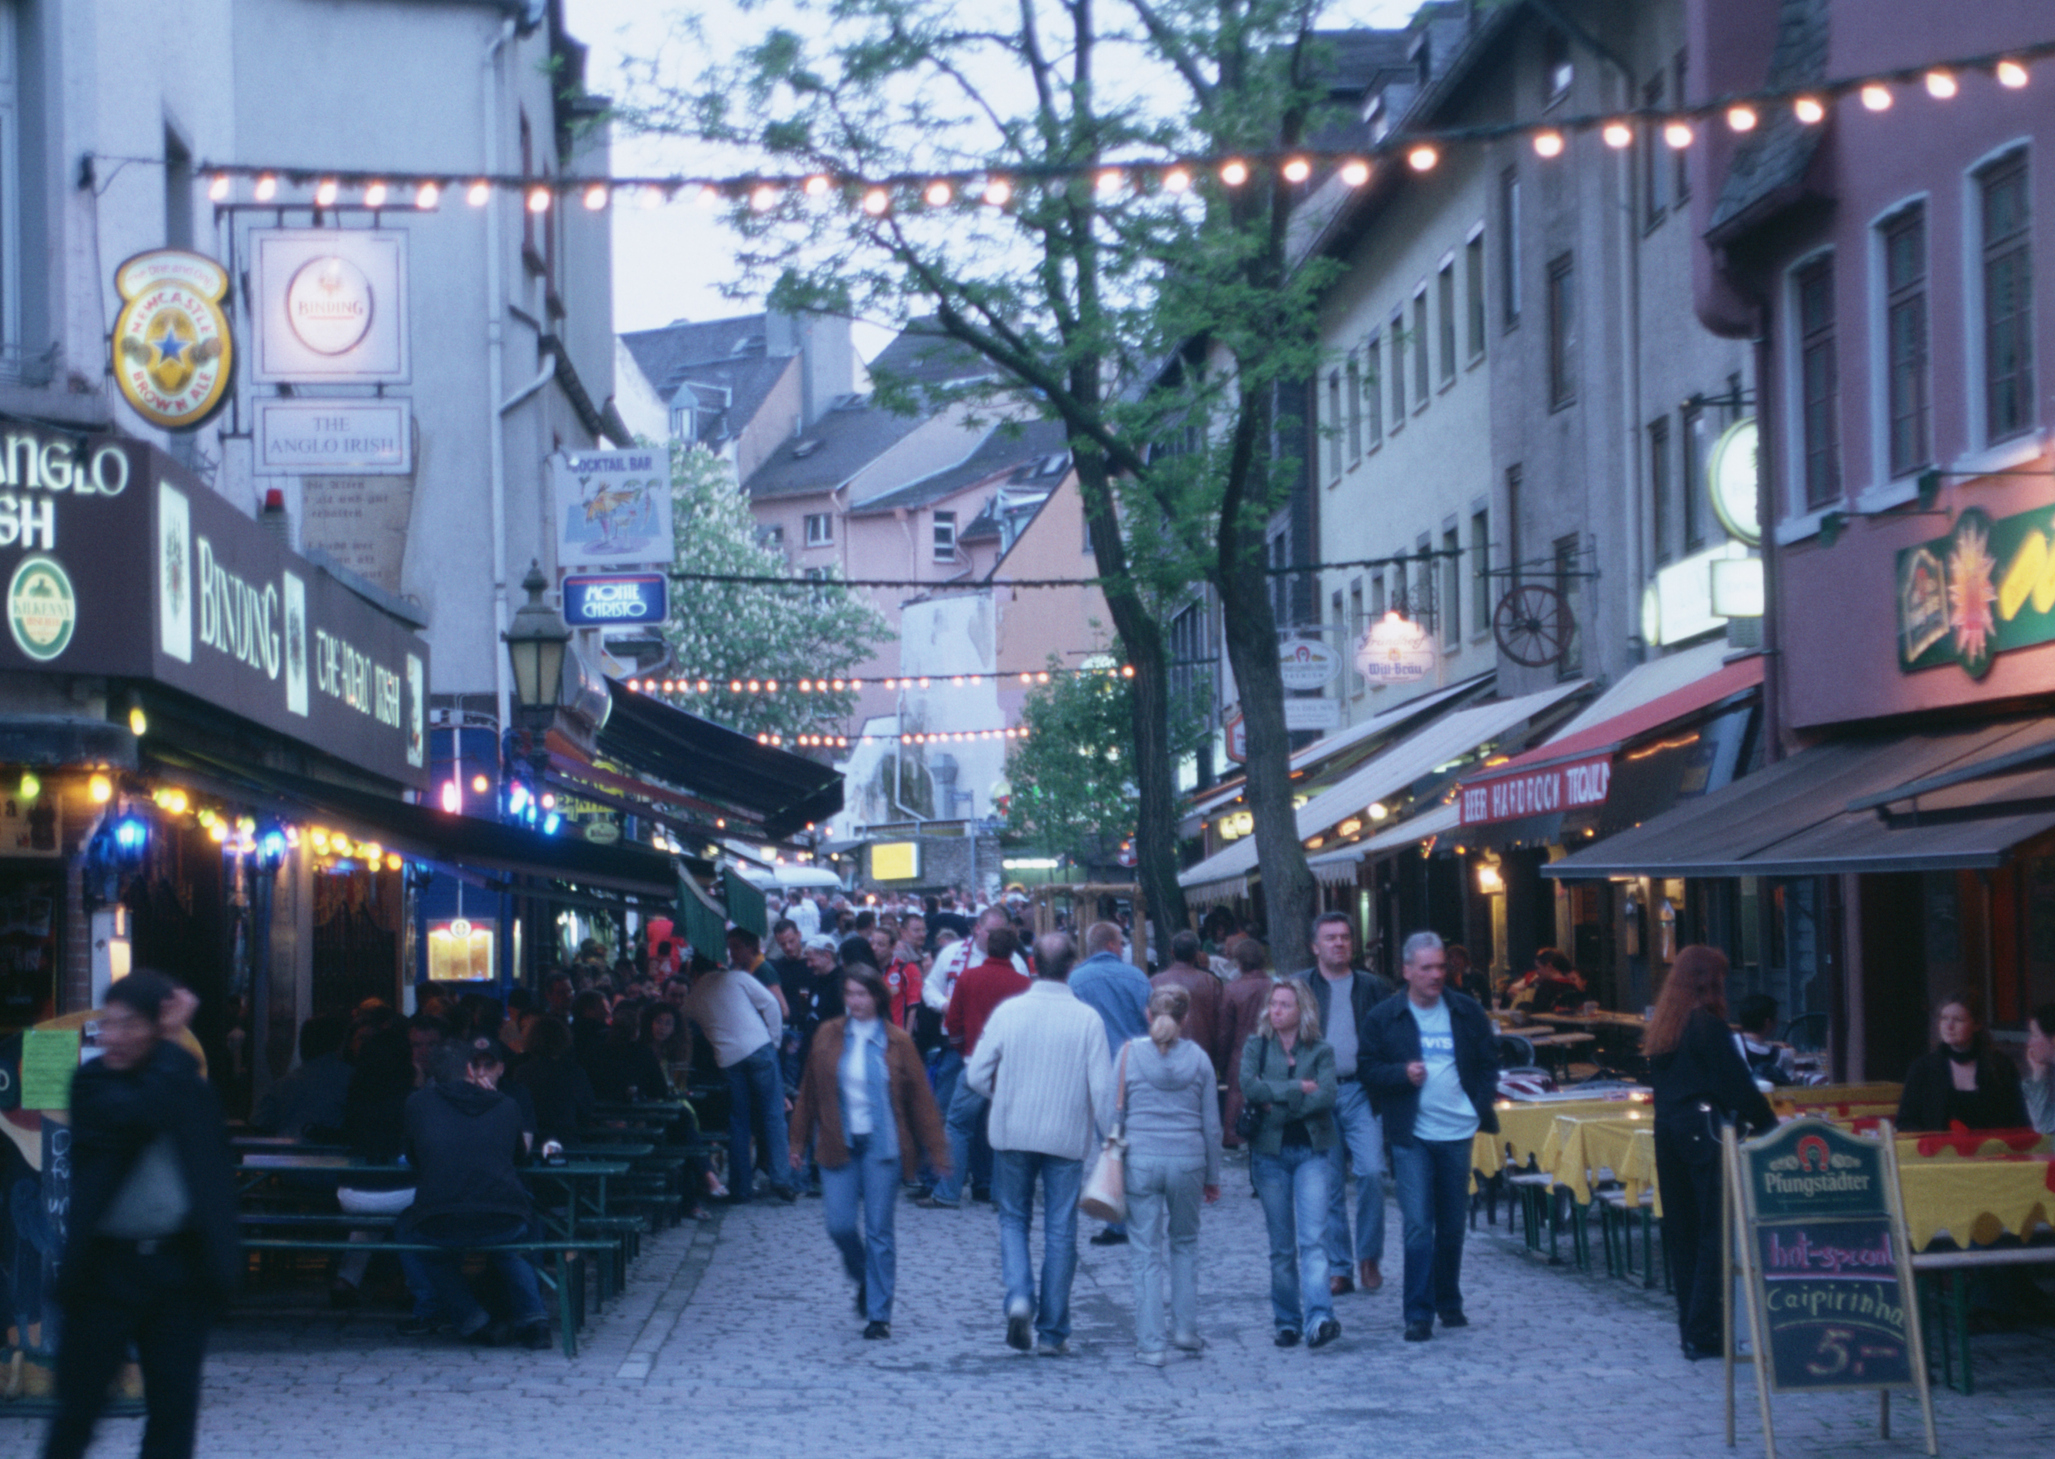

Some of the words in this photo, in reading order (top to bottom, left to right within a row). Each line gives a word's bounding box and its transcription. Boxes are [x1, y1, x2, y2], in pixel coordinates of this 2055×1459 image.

[131, 292, 213, 334] NEWCASTLE
[298, 301, 363, 316] BINDING
[133, 370, 189, 412] BROWN
[190, 372, 213, 400] ALE
[313, 417, 350, 432] THE
[271, 438, 338, 454] ANGLO
[344, 438, 393, 453] IRISH
[629, 456, 653, 471] BAR
[198, 535, 280, 681] BINDING
[317, 629, 340, 698] THE
[1764, 1172, 1870, 1197] Pfungstädter
